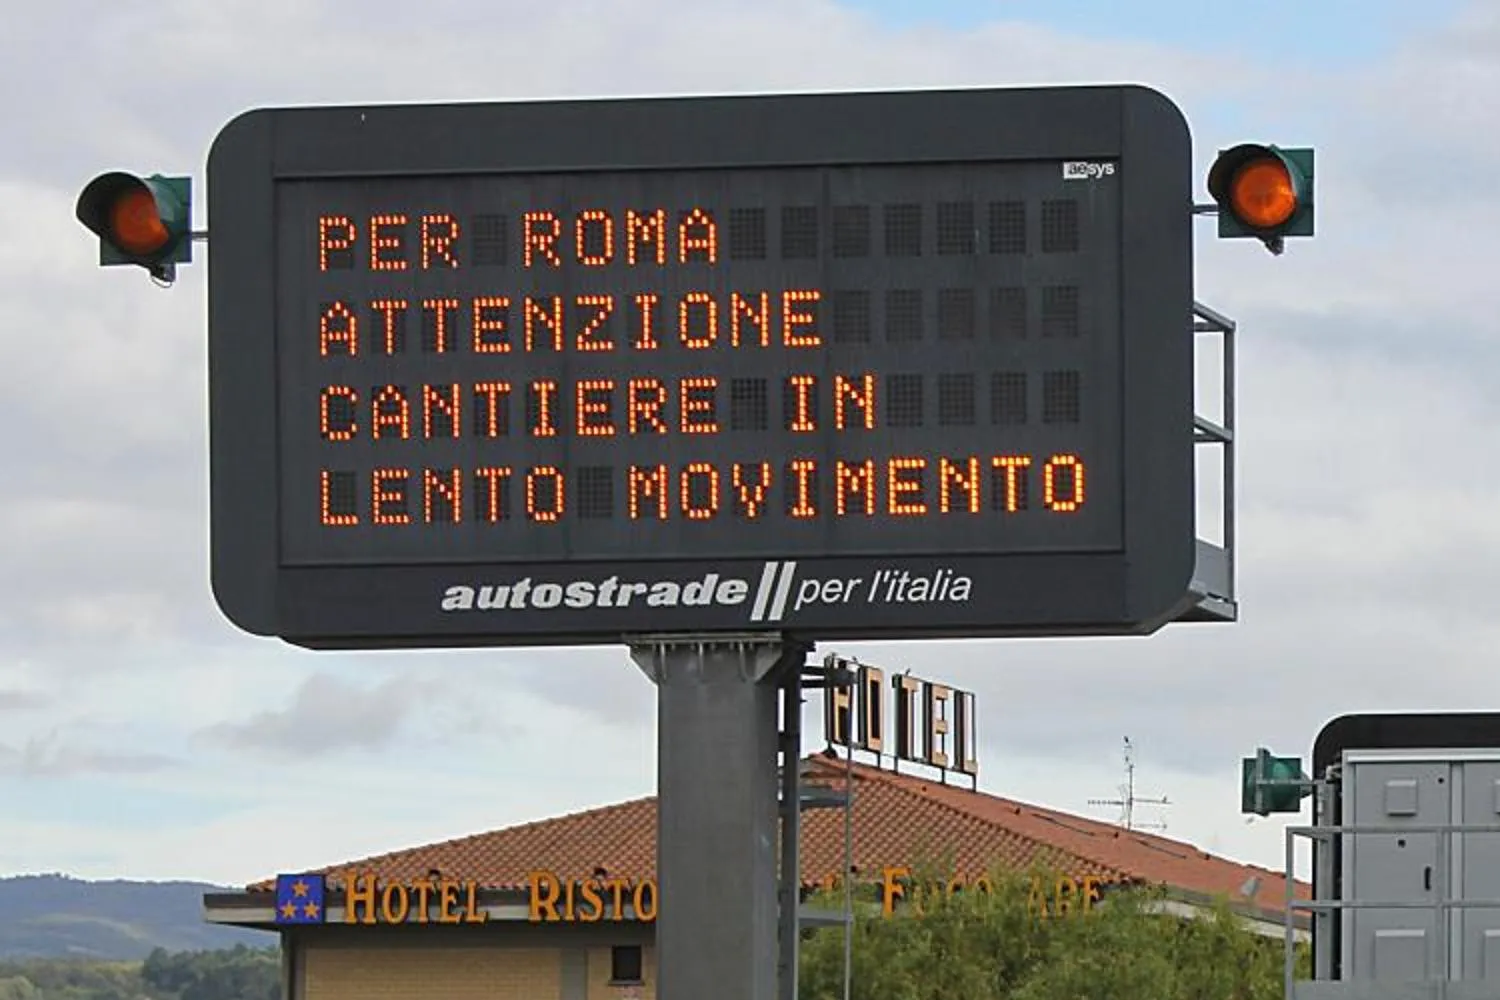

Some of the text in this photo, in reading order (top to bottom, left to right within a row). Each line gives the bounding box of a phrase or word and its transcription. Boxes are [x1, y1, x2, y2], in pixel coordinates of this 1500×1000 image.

[319, 207, 718, 271] PER ROMA
[319, 289, 822, 356] ATTENZIONE
[320, 374, 875, 441] CANTIERE IN
[321, 454, 1085, 525] LENTO MOVIMENTO
[441, 569, 973, 612] autostrade per l'italia
[824, 655, 979, 776] HOTEL
[343, 869, 489, 925] HOTEL
[527, 869, 658, 923] RISTO
